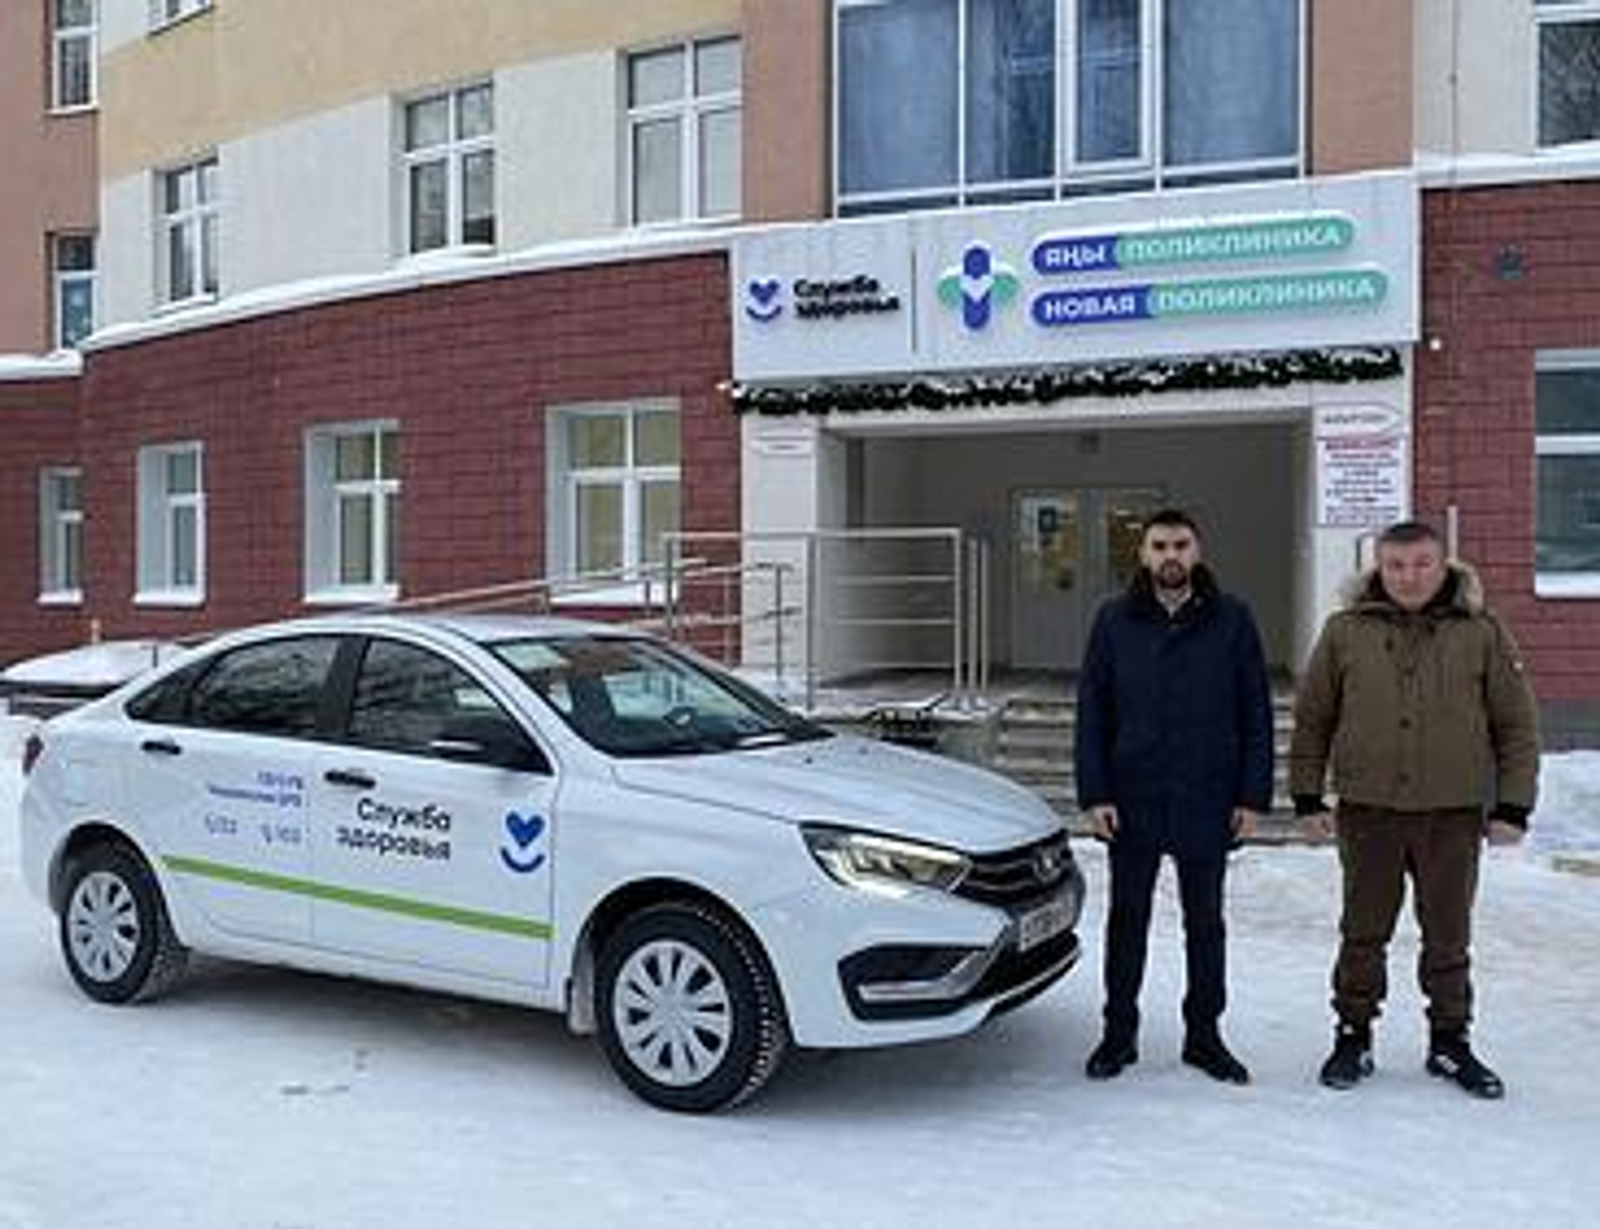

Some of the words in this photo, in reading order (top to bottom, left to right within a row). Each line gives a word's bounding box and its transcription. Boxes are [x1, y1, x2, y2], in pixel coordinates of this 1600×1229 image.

[1126, 224, 1342, 262] ПОЛИКЛИНИКА
[793, 275, 879, 304] Служба
[1044, 294, 1136, 320] НОВАЯ
[1159, 278, 1376, 314] ПОЛИКЛИНИКА
[795, 297, 900, 320] здоровья
[357, 797, 451, 831] Служба
[336, 826, 451, 860] здоровья
